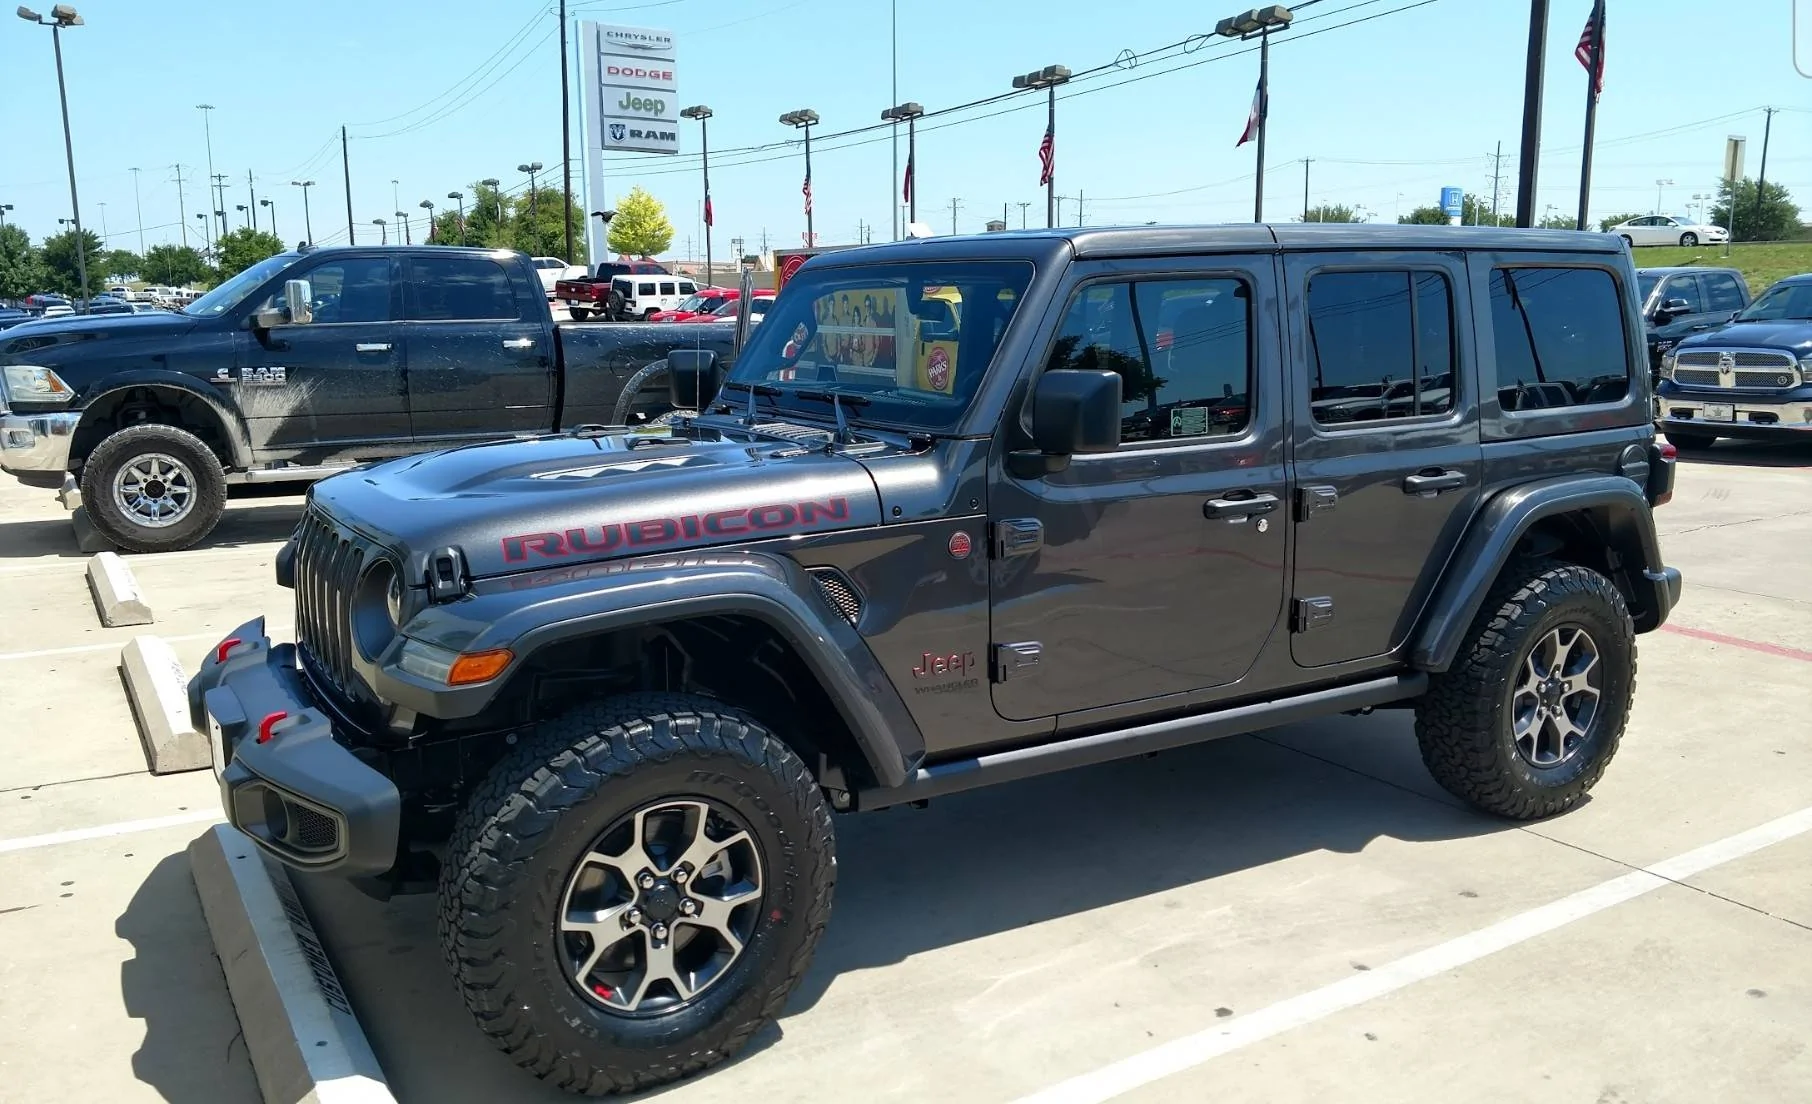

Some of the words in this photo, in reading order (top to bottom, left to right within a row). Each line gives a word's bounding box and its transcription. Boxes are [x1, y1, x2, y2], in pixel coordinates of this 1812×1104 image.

[606, 31, 671, 43] CHRYSLER
[607, 66, 673, 81] DODGE
[618, 92, 666, 117] Jeep
[629, 129, 676, 142] RAM
[928, 360, 947, 378] PARKS
[502, 497, 848, 564] RUBICON
[912, 651, 976, 679] Jeep
